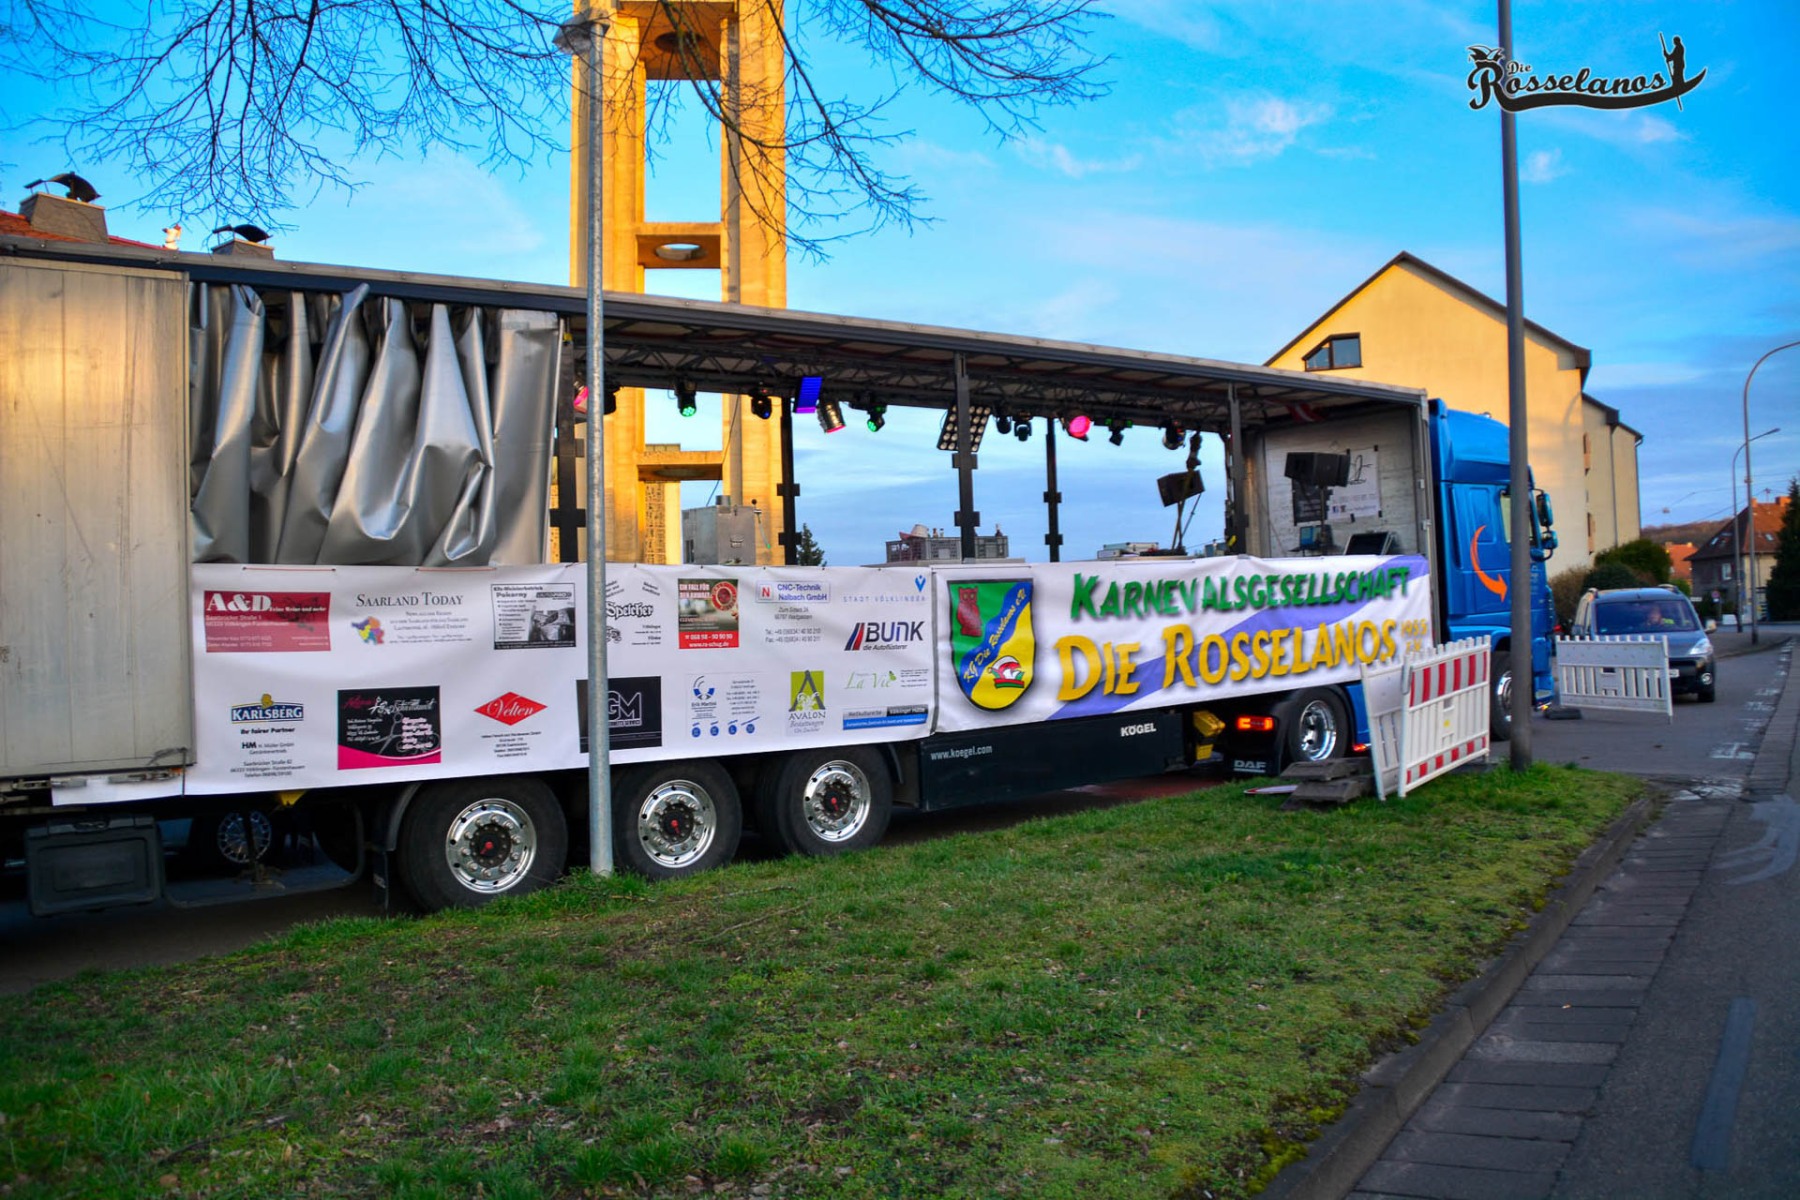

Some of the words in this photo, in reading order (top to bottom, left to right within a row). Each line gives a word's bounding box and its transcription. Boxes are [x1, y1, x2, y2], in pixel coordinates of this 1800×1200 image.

[356, 593, 419, 607] SAARLAND
[421, 591, 463, 606] TODAY
[1070, 567, 1411, 619] KARNEVALSGESELLSCHAFT
[206, 593, 272, 612] A&D
[865, 621, 925, 642] BUNK
[1401, 619, 1428, 637] 1955
[1053, 634, 1143, 702] DIE
[1162, 618, 1397, 690] ROSSELANOS
[232, 707, 302, 720] KARLSBERG
[788, 711, 826, 721] AVALON
[1120, 722, 1156, 738] KÖGEL
[930, 745, 993, 761] www.koegel.com
[1233, 760, 1266, 769] DAF
